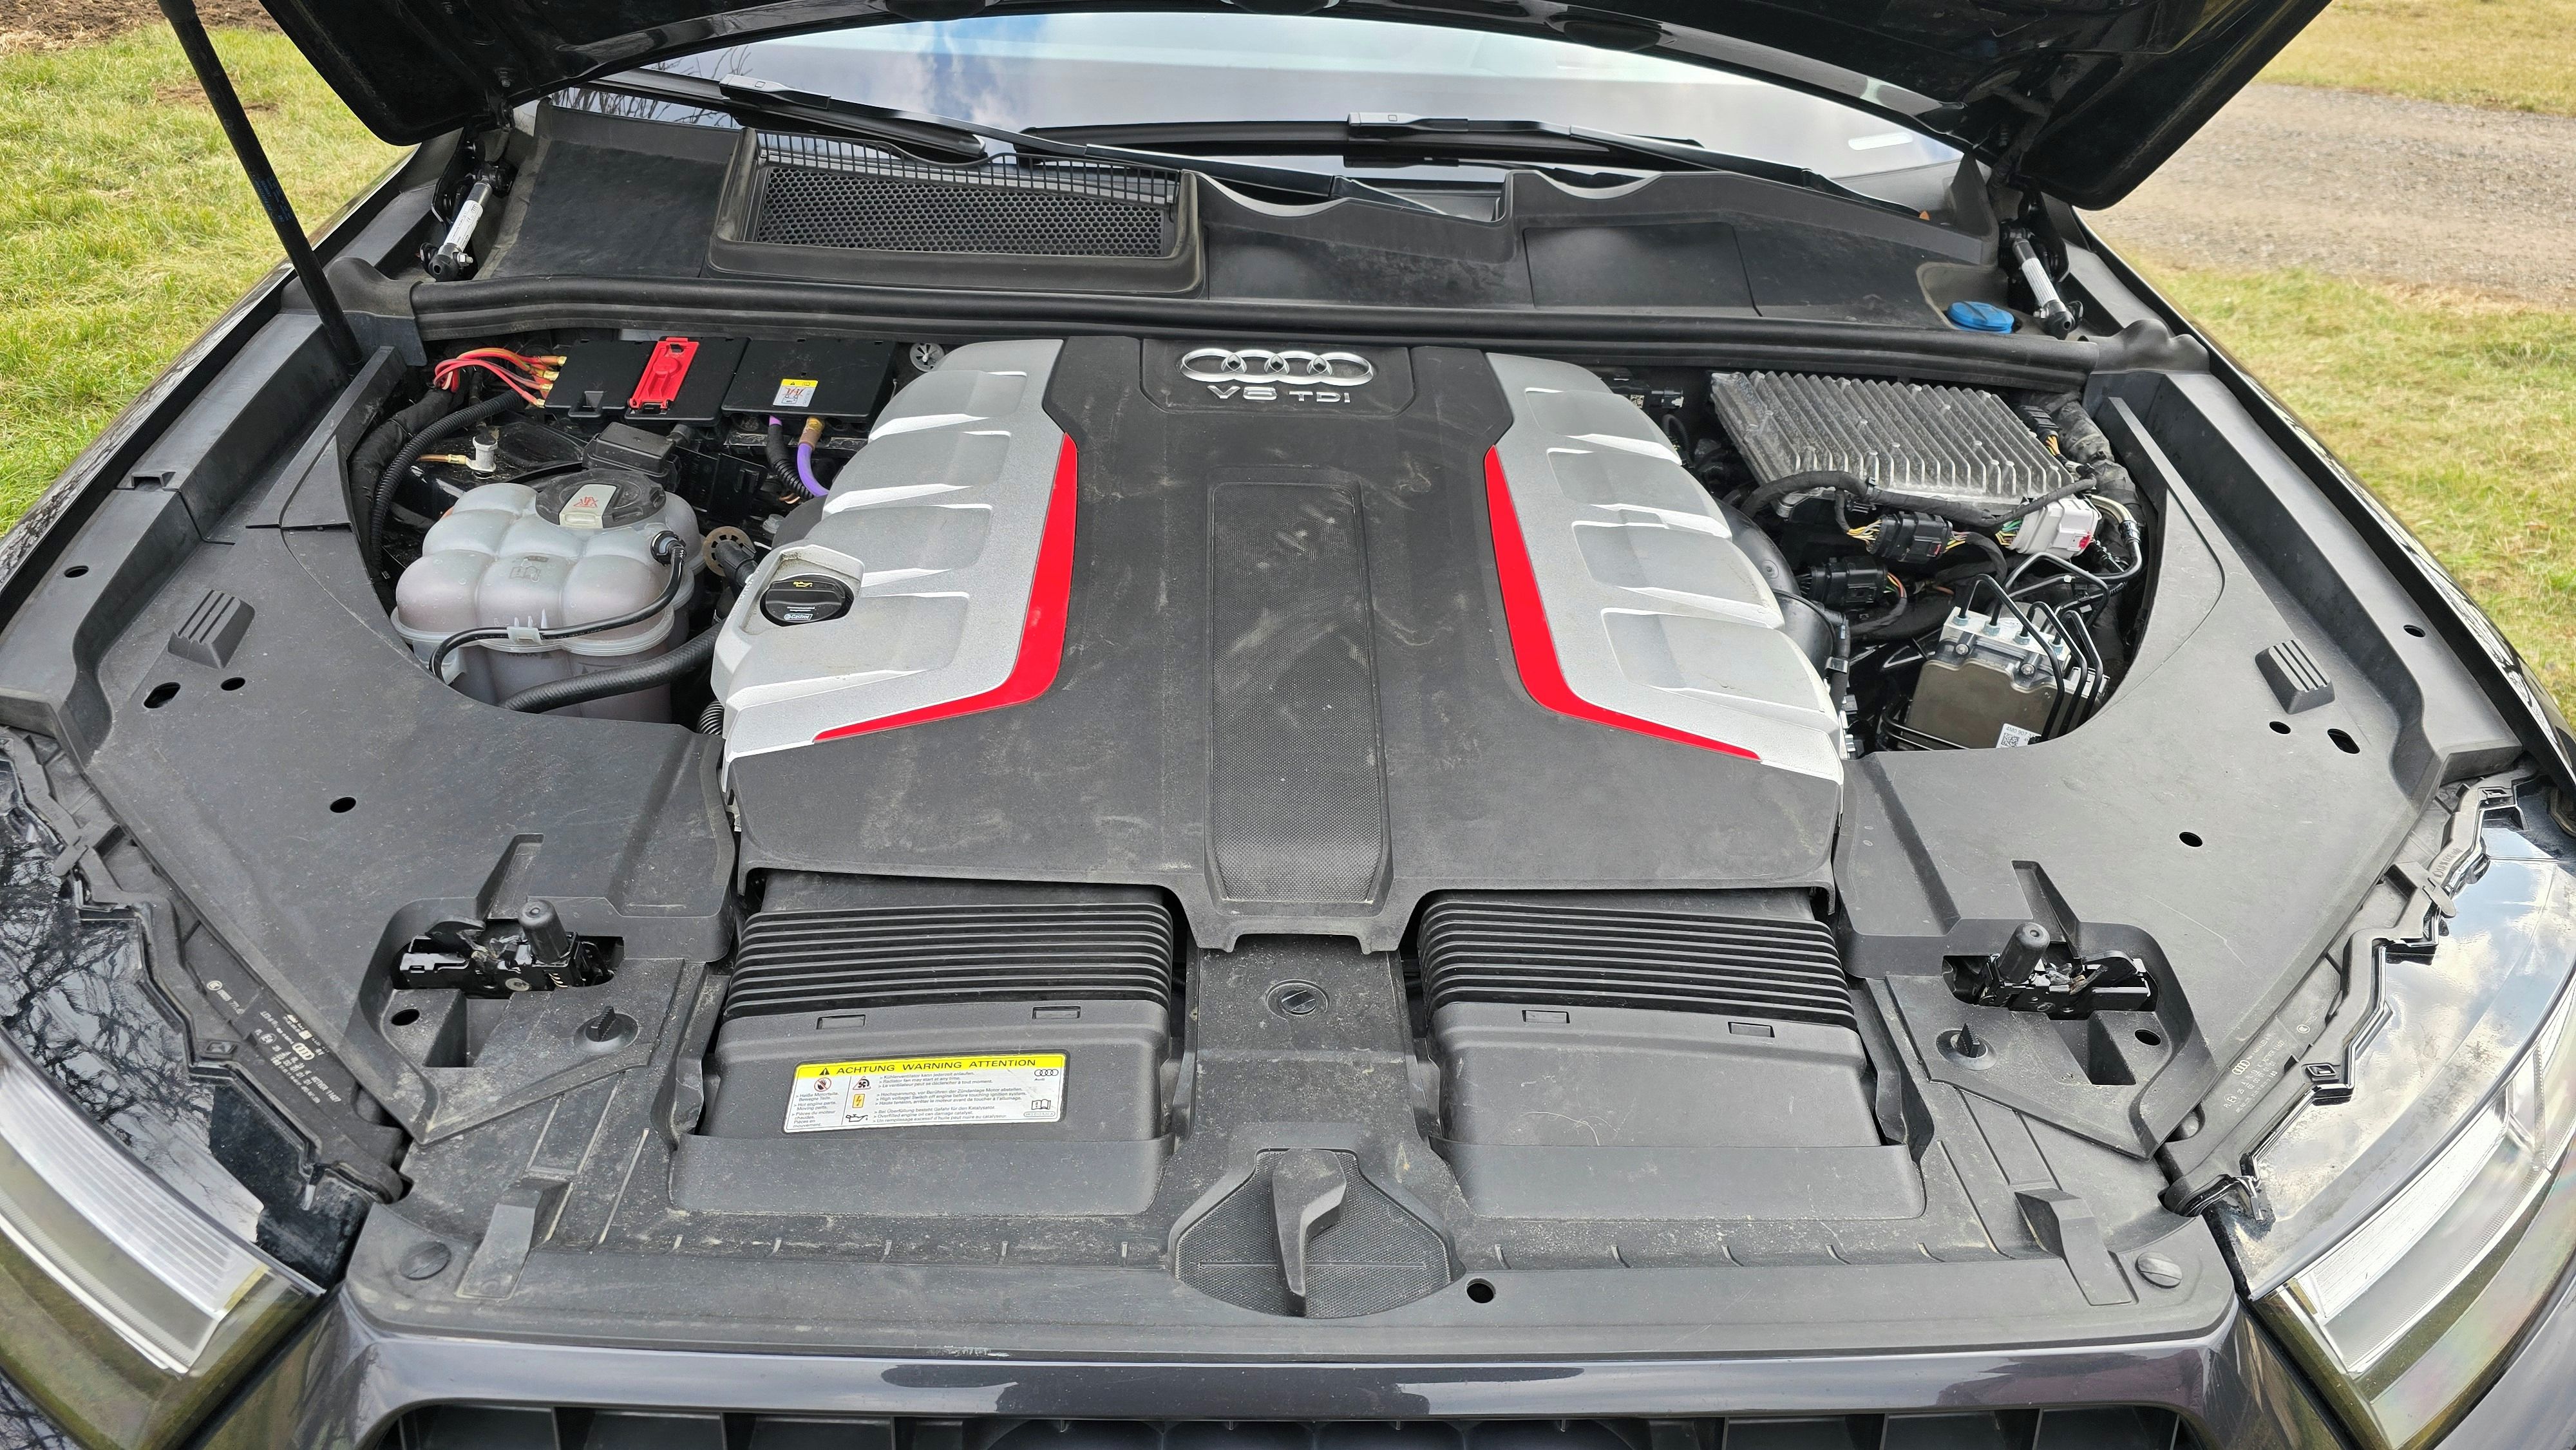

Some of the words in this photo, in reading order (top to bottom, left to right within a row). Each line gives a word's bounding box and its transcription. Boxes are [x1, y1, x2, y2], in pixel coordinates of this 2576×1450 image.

[1207, 386, 1277, 400] V8
[1289, 391, 1350, 402] TDI
[837, 1065, 895, 1074] ACHTUNG
[901, 1062, 962, 1071] WARNING
